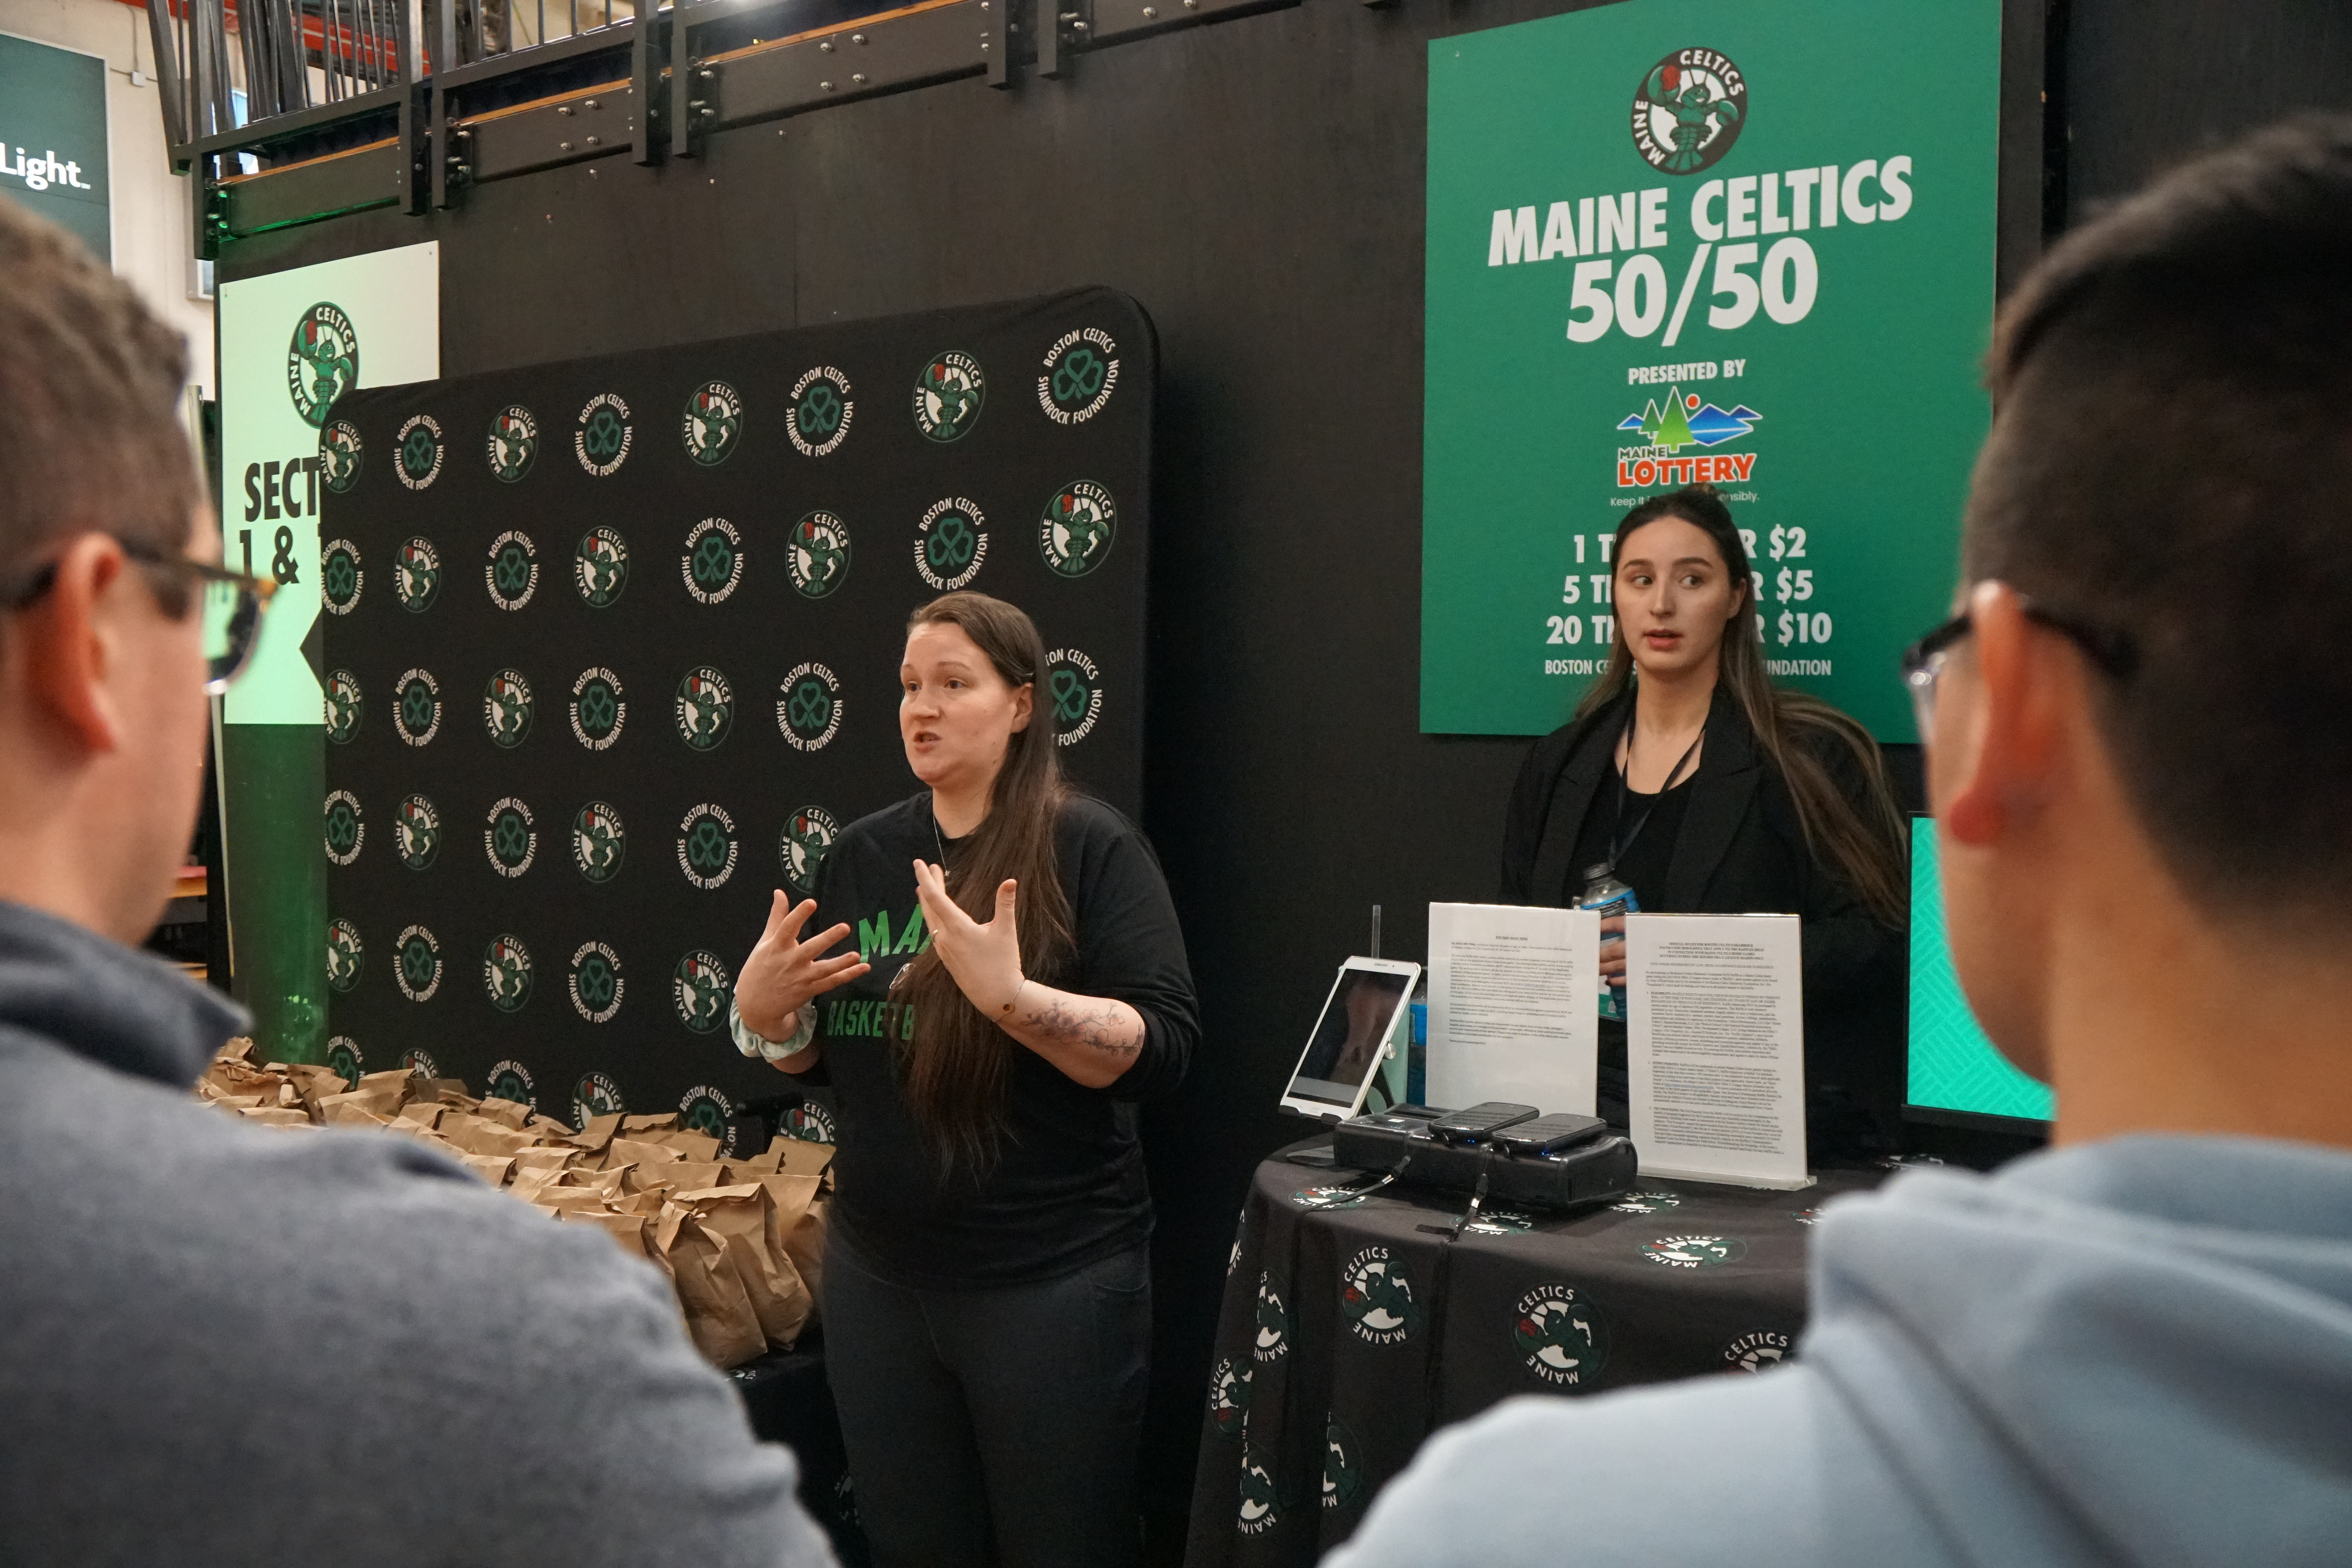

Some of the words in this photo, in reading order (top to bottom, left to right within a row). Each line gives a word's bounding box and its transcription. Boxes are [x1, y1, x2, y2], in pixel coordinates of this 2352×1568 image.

[1633, 100, 1666, 165] MAINE
[1680, 50, 1744, 96] CELTICS
[0, 142, 81, 190] Light
[1488, 187, 1668, 266] MAINE
[1691, 155, 1913, 241] CELTICS
[1566, 237, 1818, 347] 50/50
[290, 353, 311, 416] MAINE
[316, 307, 355, 353] CELTICS
[1044, 330, 1079, 367] BOSTON
[1083, 328, 1115, 353] CELTICS
[791, 367, 821, 399] BOSTON
[824, 367, 850, 393] CELTICS
[1038, 376, 1070, 424] SHAMROCK
[1073, 359, 1118, 424] FOUNDATION
[1629, 361, 1718, 385] PRESENTED
[1723, 359, 1746, 377] BY
[579, 394, 604, 423] BOSTON
[607, 394, 630, 419] CELTICS
[916, 387, 933, 432] MAINE
[946, 354, 981, 387] CELTICS
[339, 423, 360, 451] CELTICS
[398, 415, 419, 441] BOSTON
[422, 415, 441, 438] CELTICS
[489, 435, 502, 473] MAINE
[510, 408, 535, 436] CELTICS
[684, 414, 699, 456] MAINE
[709, 384, 739, 415] CELTICS
[786, 408, 813, 456] SHAMROCK
[815, 401, 853, 457] FOUNDATION
[394, 448, 414, 489] SHAMROCK
[416, 444, 443, 490] FOUNDATION
[575, 430, 598, 476] SHAMROCK
[600, 425, 632, 476] FOUNDATION
[1618, 453, 1757, 487] LOTTERY
[1619, 446, 1667, 460] MAINE
[245, 457, 320, 522] SECT
[1611, 497, 1636, 509] Keep
[686, 518, 713, 548] BOSTON
[716, 518, 740, 544] CELTICS
[919, 498, 951, 531] BOSTON
[955, 498, 984, 525] CELTICS
[1042, 519, 1061, 566] MAINE
[1074, 484, 1112, 518] CELTICS
[272, 525, 300, 585] &
[342, 539, 360, 563] CELTICS
[489, 531, 512, 558] BOSTON
[514, 531, 535, 556] CELTICS
[576, 556, 590, 597] MAINE
[598, 529, 626, 560] CELTICS
[788, 544, 805, 588] MAINE
[815, 514, 847, 546] CELTICS
[914, 539, 944, 590] SHAMROCK
[947, 532, 987, 590] FOUNDATION
[1574, 535, 1584, 563] 1
[1769, 524, 1806, 561] $2
[396, 564, 408, 603] MAINE
[414, 539, 438, 568] CELTICS
[486, 565, 507, 610] SHAMROCK
[510, 563, 538, 611] FOUNDATION
[682, 555, 707, 603] SHAMROCK
[709, 552, 743, 604] FOUNDATION
[1563, 575, 1580, 604] 5
[1777, 566, 1813, 604] $5
[339, 570, 363, 615] FOUNDATION
[1546, 615, 1582, 644] 20
[1778, 609, 1832, 647] $10
[396, 668, 417, 695] BOSTON
[419, 669, 438, 694] CELTICS
[573, 667, 597, 695] BOSTON
[600, 668, 622, 694] CELTICS
[780, 663, 809, 693] BOSTON
[813, 663, 839, 691] CELTICS
[1067, 649, 1098, 680] CELTICS
[1545, 659, 1592, 675] BOSTON
[338, 672, 360, 702] CELTICS
[485, 697, 499, 737] MAINE
[505, 671, 530, 703] CELTICS
[677, 696, 692, 740] MAINE
[700, 669, 730, 702] CELTICS
[393, 701, 414, 746] SHAMROCK
[416, 701, 441, 747] FOUNDATION
[570, 702, 593, 750] SHAMROCK
[595, 702, 625, 751] FOUNDATION
[777, 700, 804, 750] SHAMROCK
[806, 699, 842, 751] FOUNDATION
[1058, 689, 1102, 746] FOUNDATION
[343, 791, 361, 816] CELTICS
[488, 797, 510, 823] BOSTON
[512, 799, 533, 825] CELTICS
[681, 804, 707, 831] BOSTON
[710, 804, 734, 832] CELTICS
[340, 823, 364, 866] FOUNDATION
[396, 820, 408, 859] MAINE
[414, 797, 437, 828] CELTICS
[573, 829, 588, 871] MAINE
[594, 804, 622, 837] CELTICS
[782, 836, 799, 881] MAINE
[807, 809, 838, 837] CELTIC
[485, 829, 506, 877] SHAMROCK
[508, 832, 536, 878] FOUNDATION
[677, 838, 702, 888] SHAMROCK
[705, 840, 737, 889] FOUNDATION
[339, 921, 361, 952] CELTICS
[396, 925, 417, 949] BOSTON
[419, 926, 438, 952] CELTICS
[572, 942, 596, 967] BOSTON
[598, 943, 621, 970] CELTICS
[394, 955, 414, 1000] SHAMROCK
[416, 960, 441, 1002] FOUNDATION
[485, 960, 498, 1000] MAINE
[504, 937, 530, 969] CELTICS
[675, 977, 690, 1021] MAINE
[698, 953, 726, 988] CELTICS
[569, 973, 592, 1021] SHAMROCK
[594, 978, 624, 1023] FOUNDATION
[827, 1001, 914, 1040] BASKETB
[345, 1037, 363, 1063] CELTICS
[414, 1051, 437, 1077] CELTIC
[488, 1060, 510, 1084] BOSTON
[512, 1062, 533, 1089] CELTICS
[573, 1097, 583, 1129] AINE
[593, 1075, 621, 1110] CELTICS
[679, 1086, 706, 1111] BOSTON
[708, 1088, 732, 1117] CELTICS
[1644, 1252, 1697, 1268] MAINE
[1656, 1236, 1723, 1245] CELTICS
[1344, 1247, 1388, 1282] CELTICS
[1518, 1285, 1574, 1313] CELTICS
[1353, 1322, 1406, 1344] MAINE
[1725, 1332, 1788, 1361] CELTICS
[1212, 1358, 1230, 1410] CELTICS
[1526, 1356, 1579, 1384] MAINE
